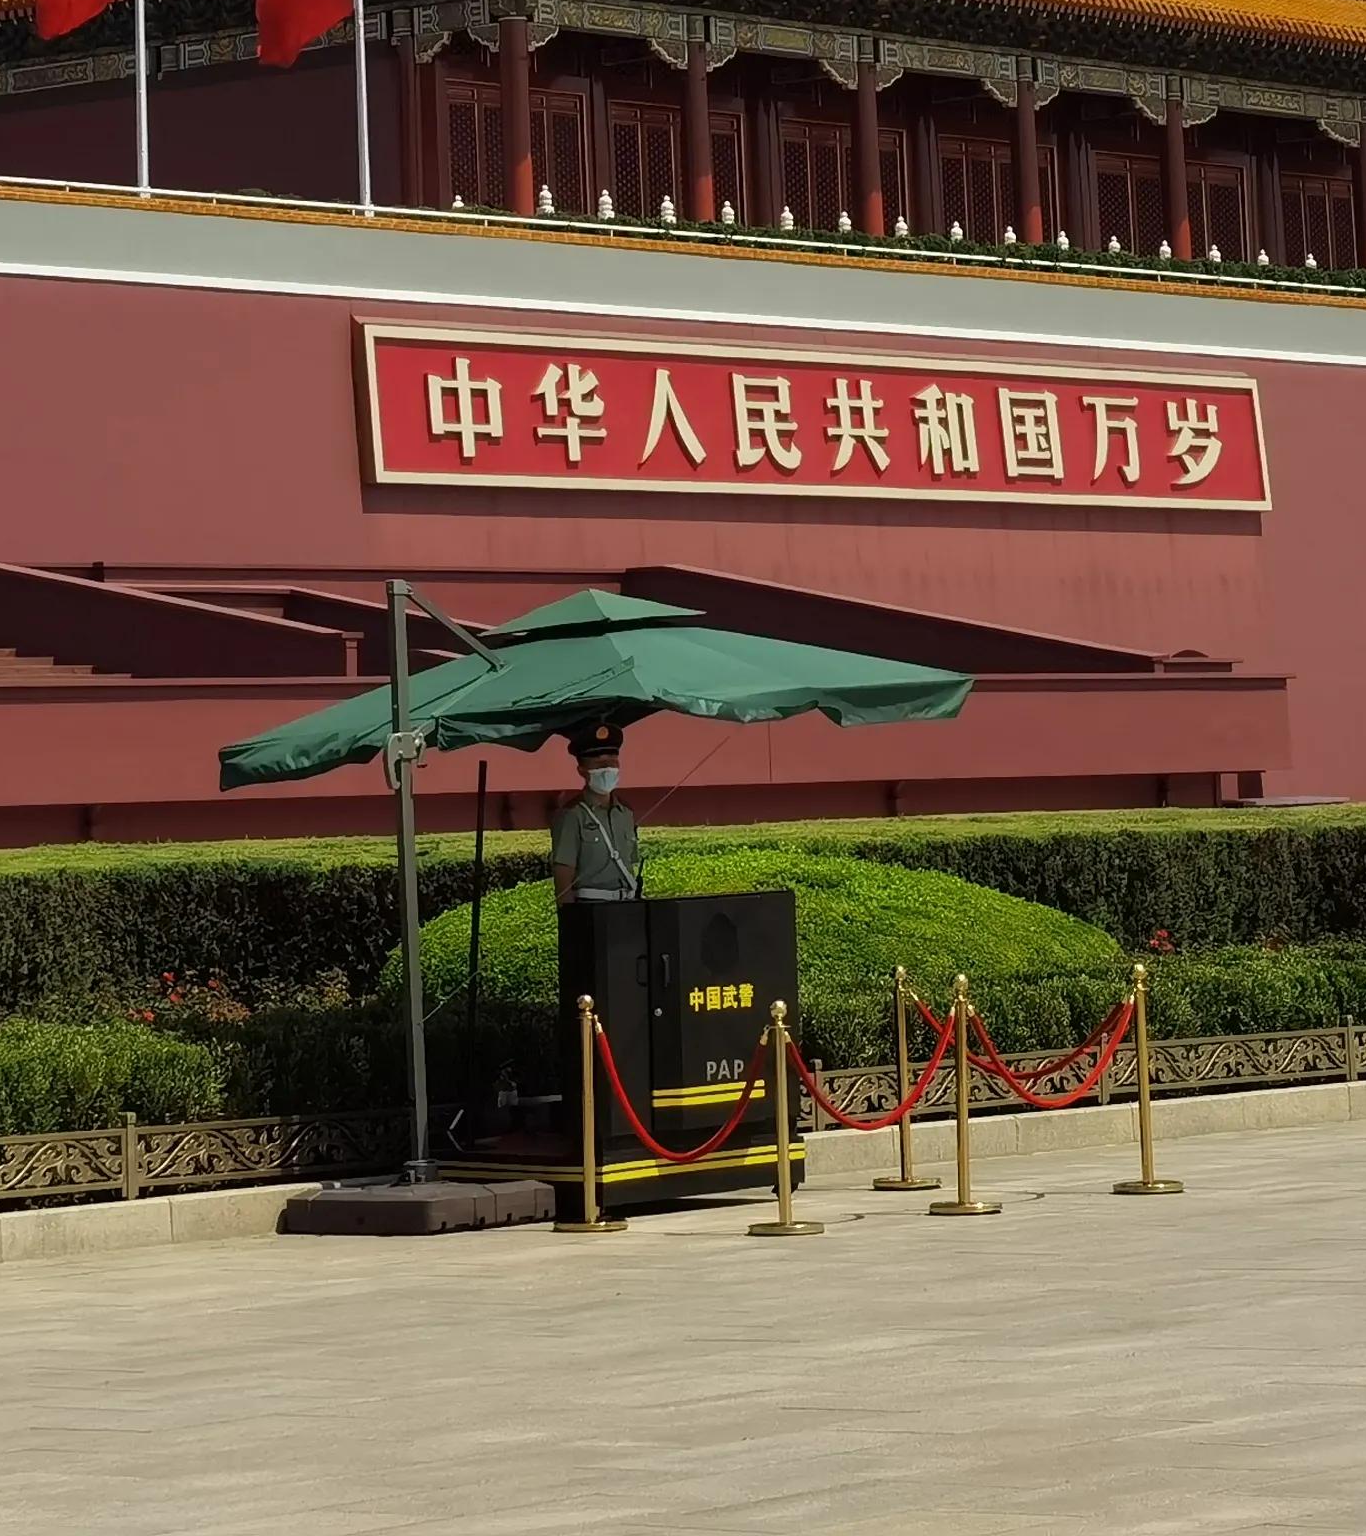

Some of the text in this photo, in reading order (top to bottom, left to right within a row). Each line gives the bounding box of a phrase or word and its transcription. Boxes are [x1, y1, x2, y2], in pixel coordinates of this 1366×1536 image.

[425, 356, 1223, 486] 中华人民共和国万岁
[689, 983, 754, 1012] 中国武警
[706, 1059, 745, 1081] PAP
